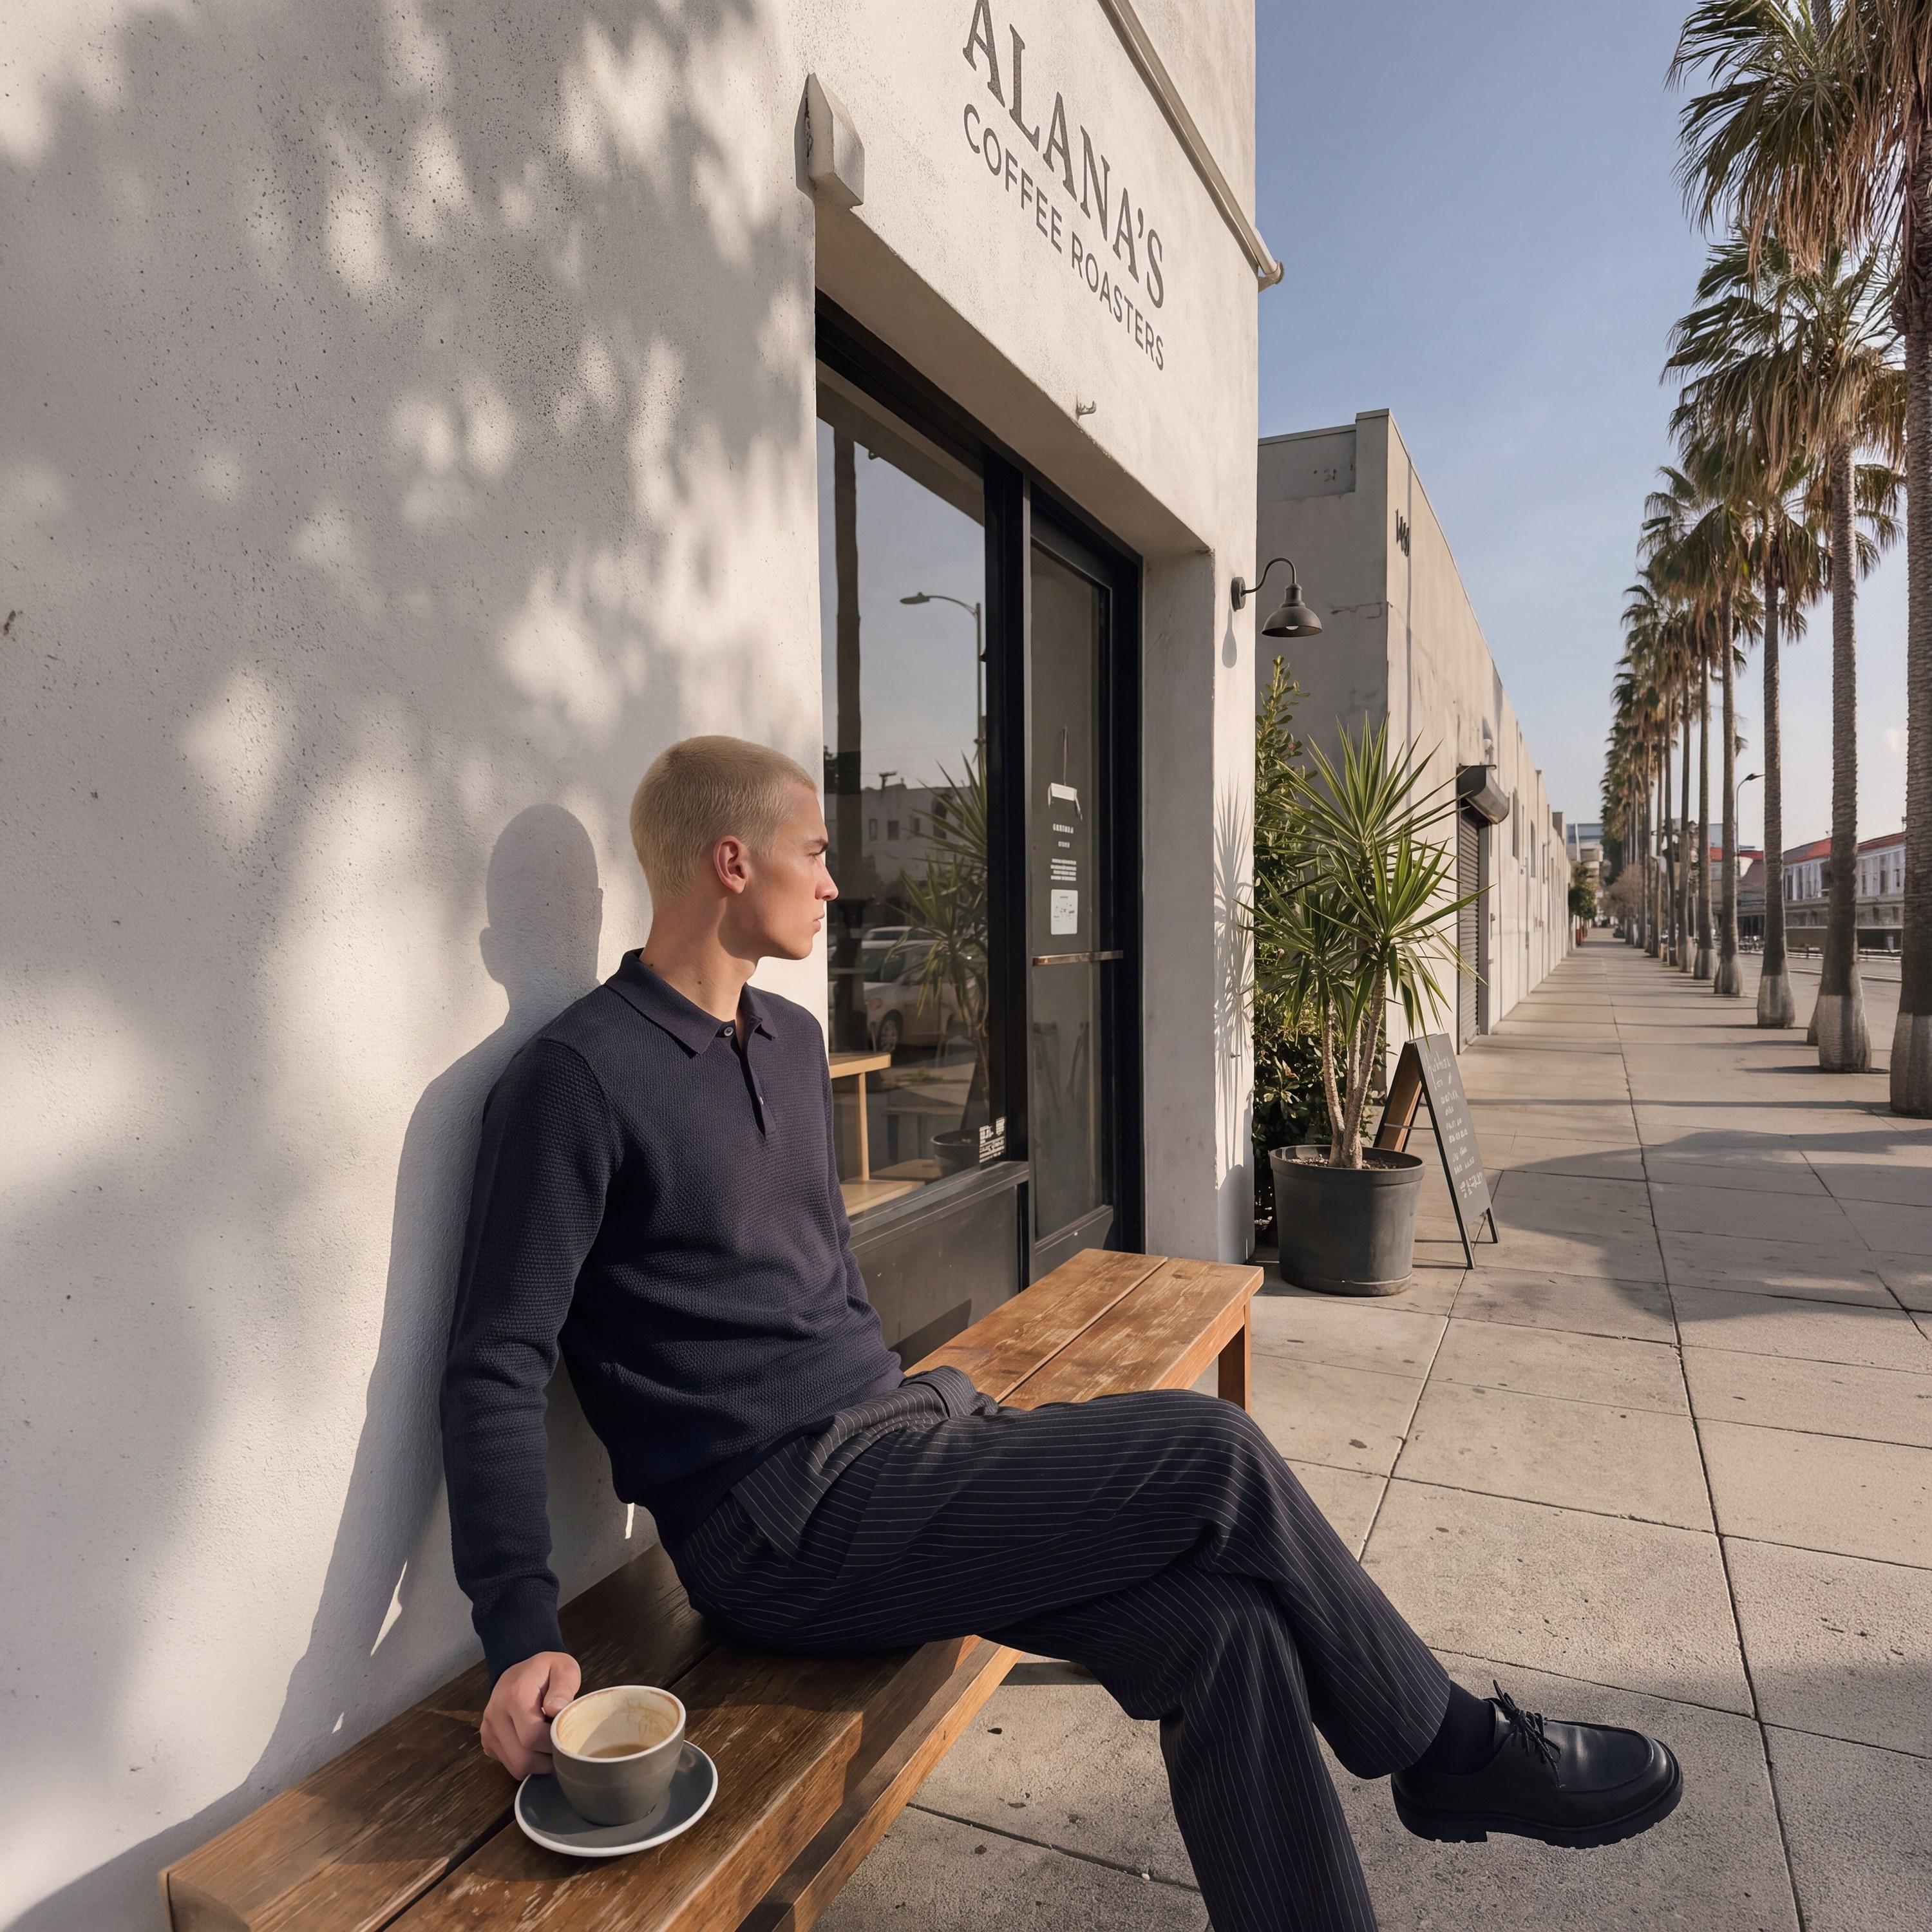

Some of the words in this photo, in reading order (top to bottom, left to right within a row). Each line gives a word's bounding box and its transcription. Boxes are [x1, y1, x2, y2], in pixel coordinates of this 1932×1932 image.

[963, 0, 1164, 308] ALANA'S
[963, 104, 1062, 254] COFFEE
[1072, 231, 1164, 371] ROASTERS
